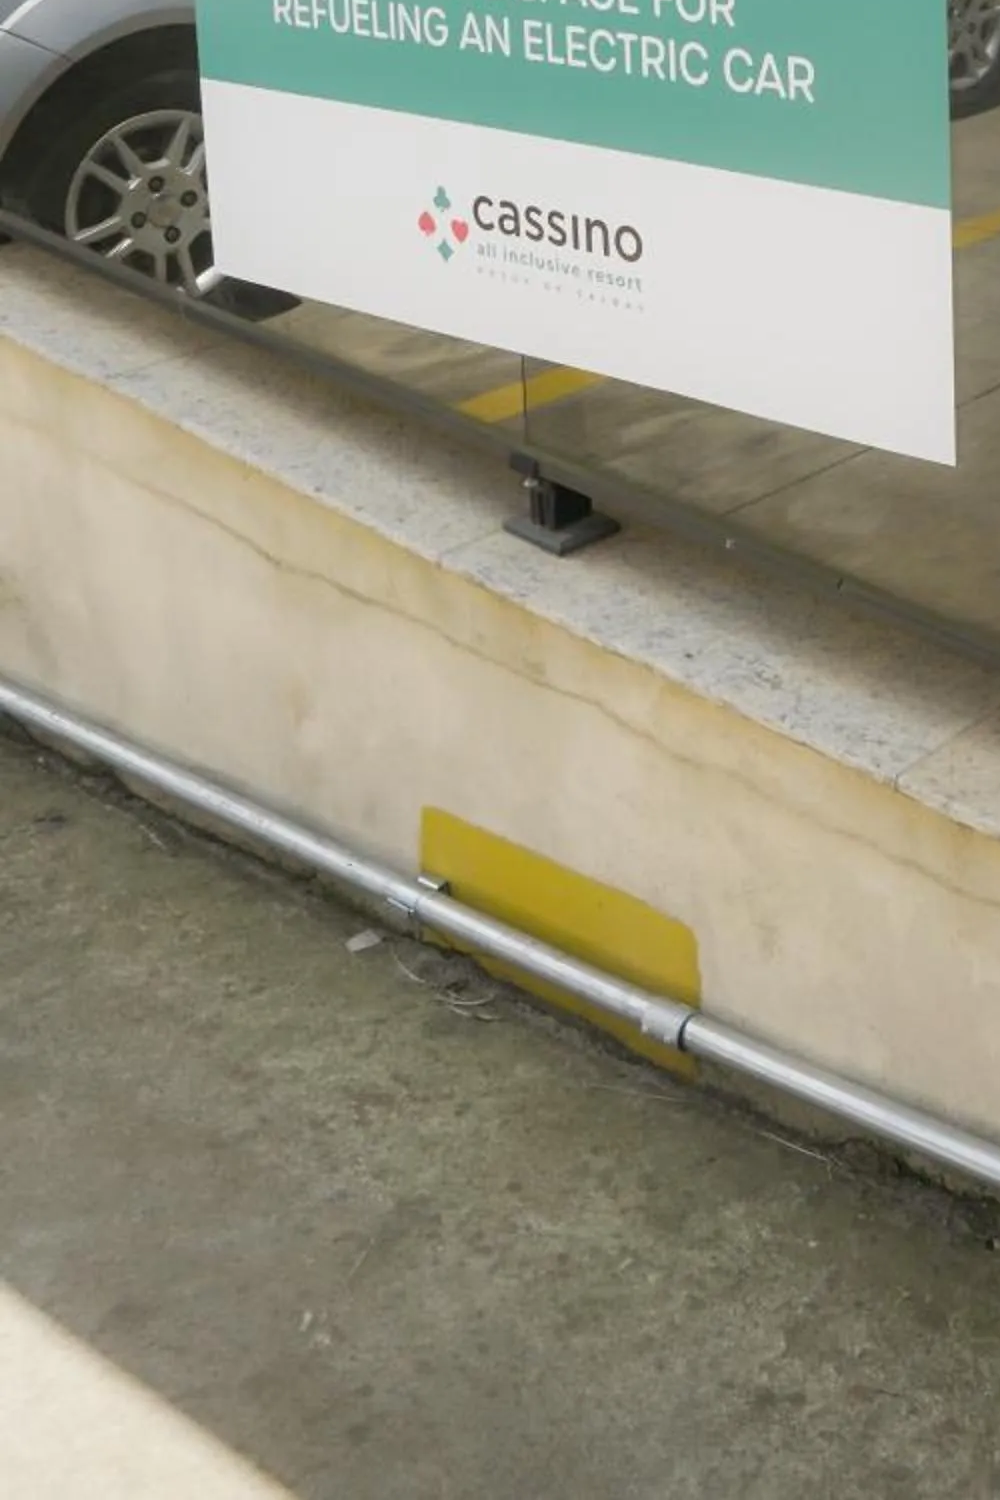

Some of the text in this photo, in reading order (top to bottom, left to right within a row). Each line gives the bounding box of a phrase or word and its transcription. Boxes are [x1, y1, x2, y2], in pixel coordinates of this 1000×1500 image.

[459, 12, 511, 57] AN
[522, 19, 709, 86] ELECTRIC
[722, 47, 815, 102] CAR
[472, 195, 643, 263] cassino
[477, 242, 497, 258] all
[503, 246, 581, 278] inclusive
[587, 269, 644, 293] resort
